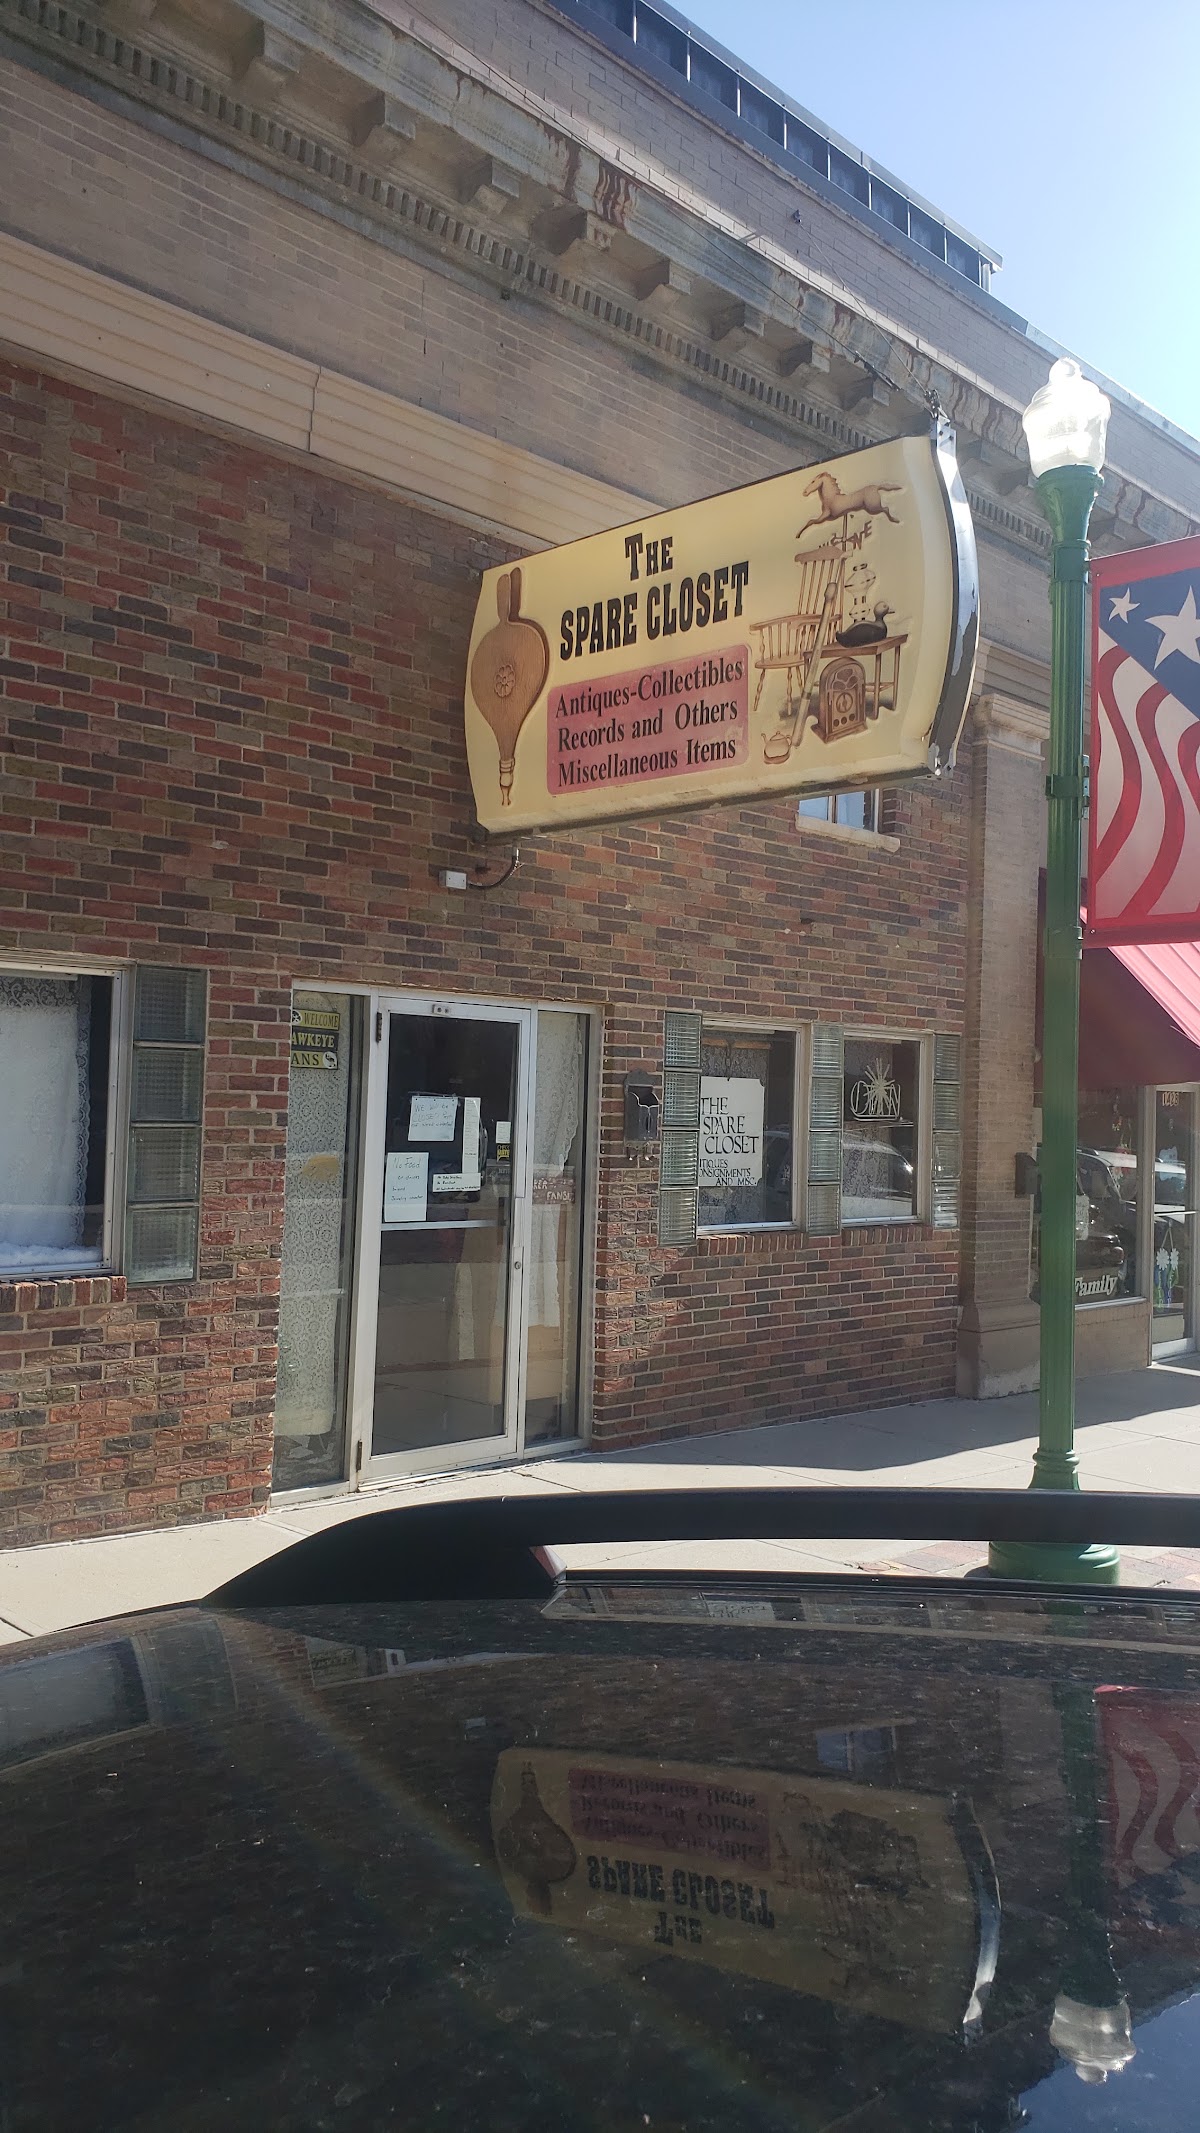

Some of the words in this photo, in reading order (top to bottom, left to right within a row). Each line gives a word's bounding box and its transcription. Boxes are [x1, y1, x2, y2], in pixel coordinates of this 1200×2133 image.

[625, 533, 673, 581] THE
[560, 592, 638, 661] SPARE
[646, 561, 749, 640] CLOSET
[555, 658, 743, 718] Antiques-Collectibles
[558, 718, 625, 752] Records
[631, 708, 663, 739] and
[675, 699, 737, 730] Others
[558, 750, 678, 787] Miscellaneous
[686, 738, 736, 765] Items
[304, 1012, 339, 1028] WELCOME
[291, 1032, 335, 1048] AWKEYE
[291, 1053, 319, 1066] ANS
[701, 1097, 729, 1115] THE
[703, 1115, 746, 1135] SPARE
[704, 1135, 760, 1155] CLOSET
[699, 1158, 728, 1168] TIQUES
[699, 1168, 751, 1178] ONSIGNMENTS
[716, 1177, 733, 1186] AND
[1075, 1275, 1118, 1296] Family
